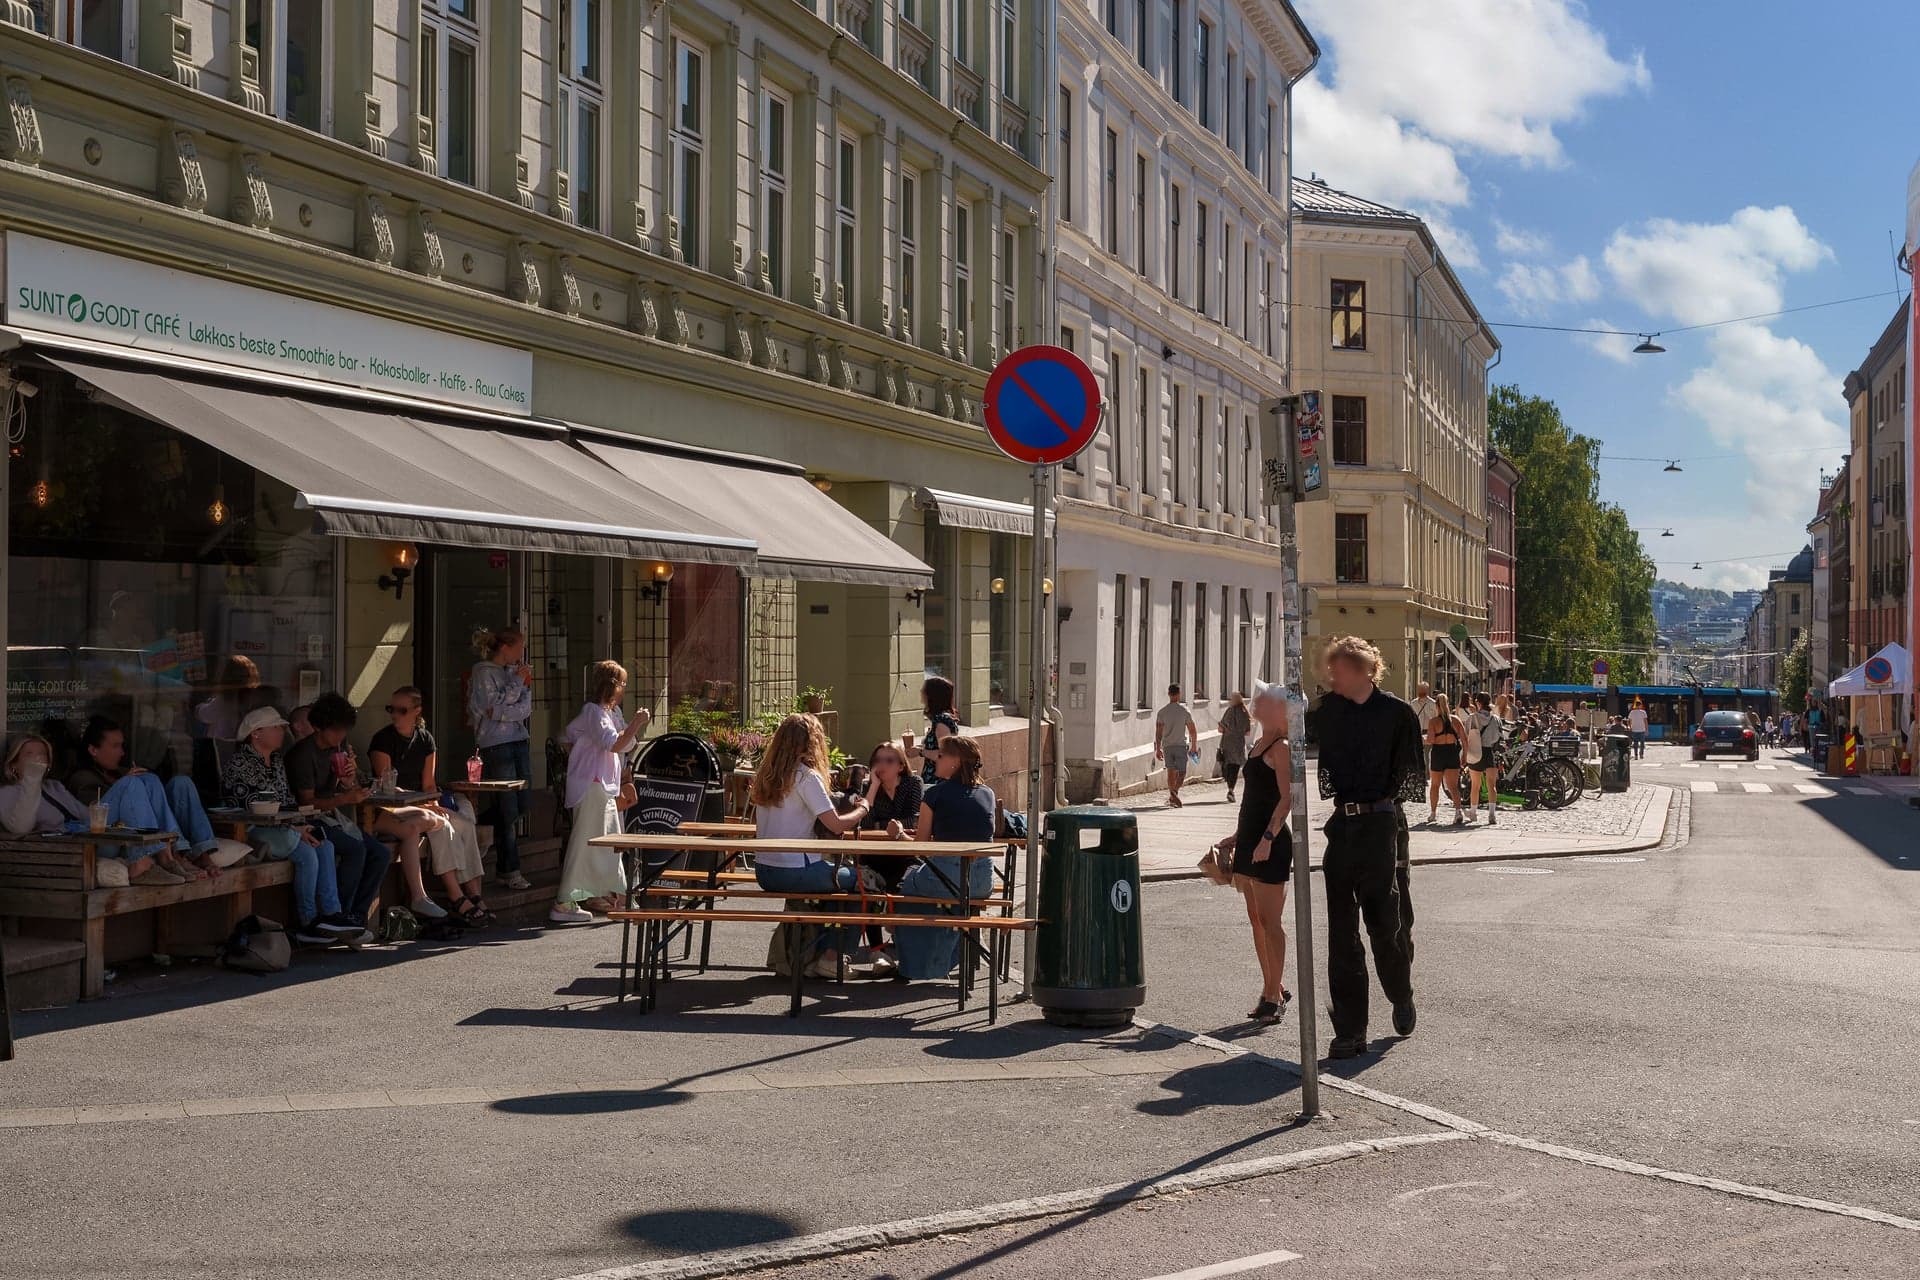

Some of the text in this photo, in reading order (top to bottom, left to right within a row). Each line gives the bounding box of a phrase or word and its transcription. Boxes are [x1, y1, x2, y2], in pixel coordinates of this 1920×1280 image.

[19, 286, 65, 316] SUNT
[90, 301, 140, 330] GODT
[144, 312, 181, 338] CAFÉ
[189, 321, 236, 349] Løkkas
[239, 331, 276, 356] beste
[279, 340, 335, 366] Smoothie
[338, 350, 359, 371] bar
[369, 356, 431, 385] Kokosboller
[440, 370, 466, 392] Kaffe
[475, 378, 497, 398] Raw
[498, 383, 526, 403] Cakes
[639, 786, 697, 803] Velkommen til
